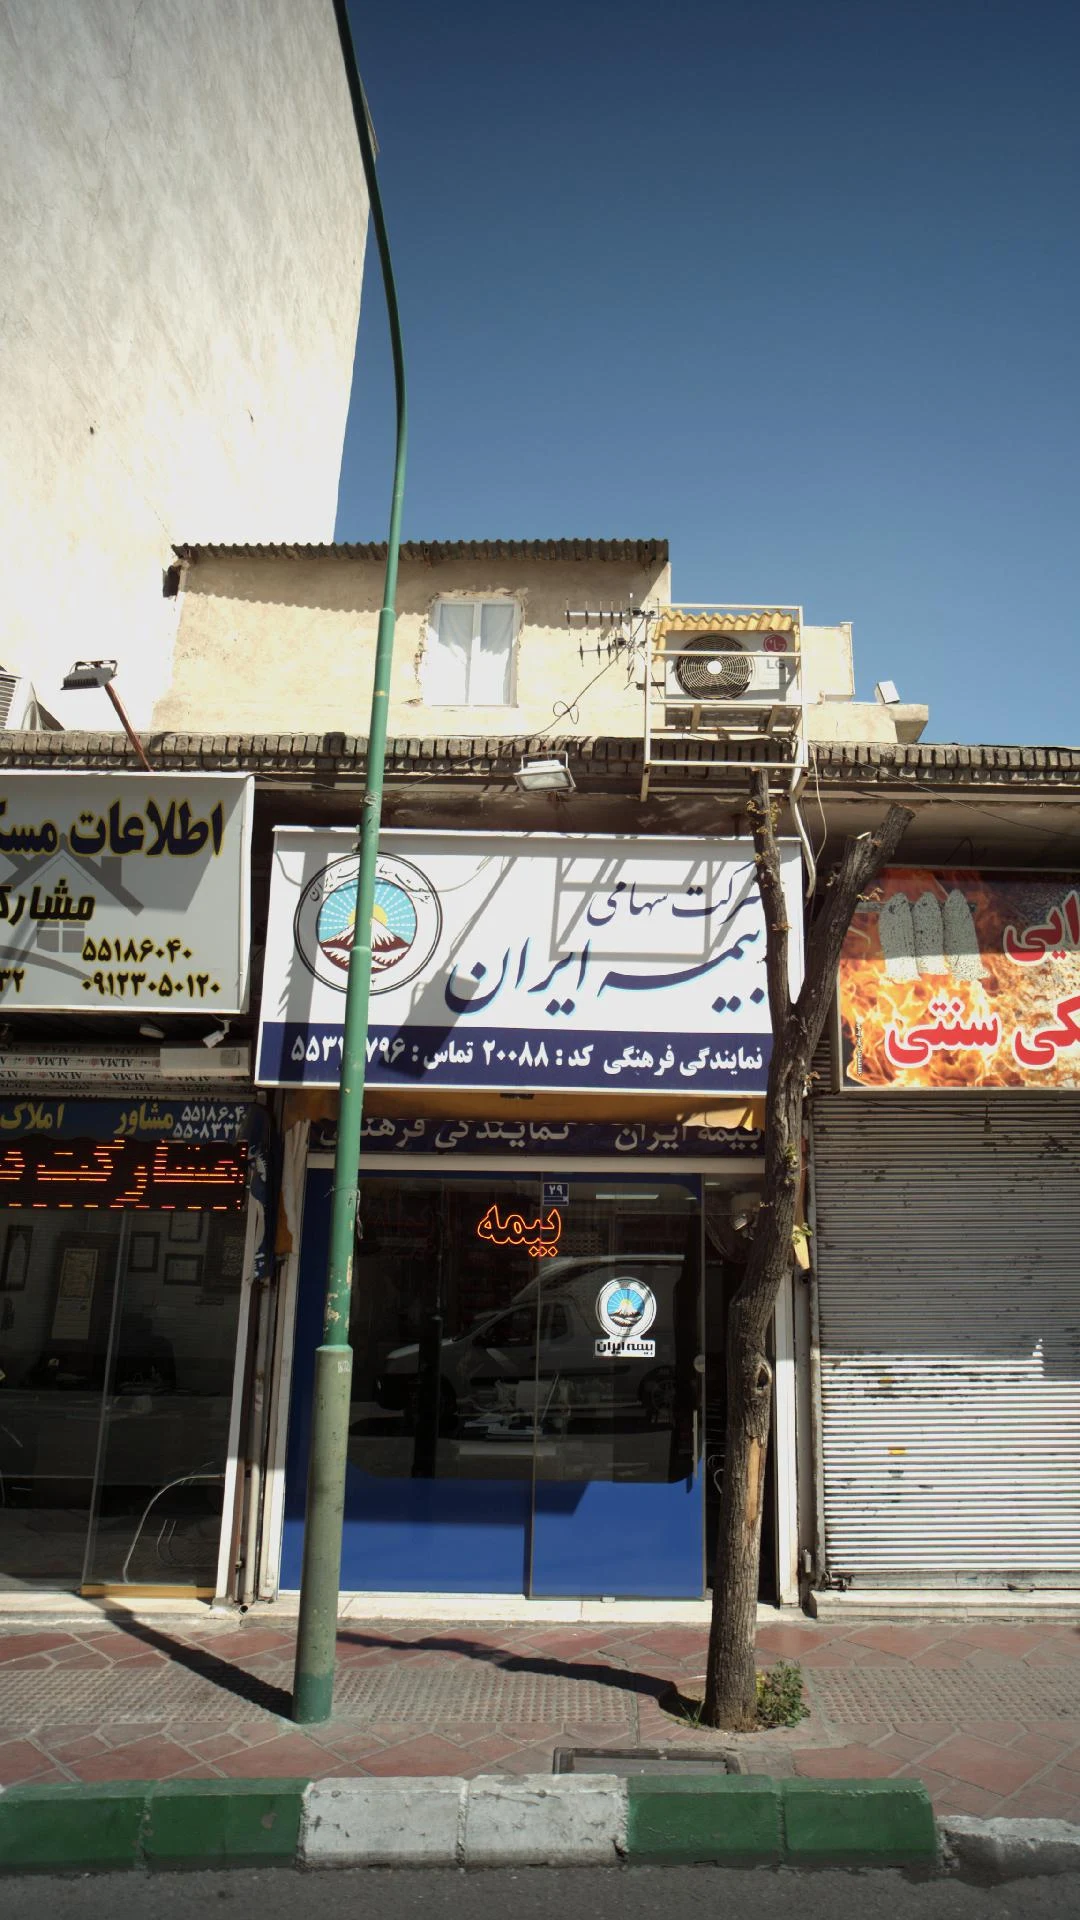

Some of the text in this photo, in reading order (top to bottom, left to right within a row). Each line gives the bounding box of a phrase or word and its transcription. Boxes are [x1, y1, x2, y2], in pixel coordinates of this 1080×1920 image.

[766, 659, 785, 669] LG
[69, 798, 224, 857] اطلاعات
[587, 860, 762, 926] رکت سهامی
[82, 937, 192, 963] ۵۵۱۸۶۰۴۰
[82, 971, 220, 998] ۰۹۱۲۳۰۵۰۱۲۰
[443, 928, 766, 1018] بیمه ایران
[887, 1001, 999, 1065] سنتی
[482, 1039, 549, 1068] ۲۰۰۸۸
[603, 1044, 675, 1077] فرهنگی
[679, 1046, 763, 1077] نمایندگی
[0, 1101, 174, 1135] مشاور املاک
[614, 1123, 687, 1151] ایران
[698, 1124, 762, 1150] بیمه
[477, 1203, 562, 1257] بیمه
[596, 1341, 653, 1355] بیمه ایران
